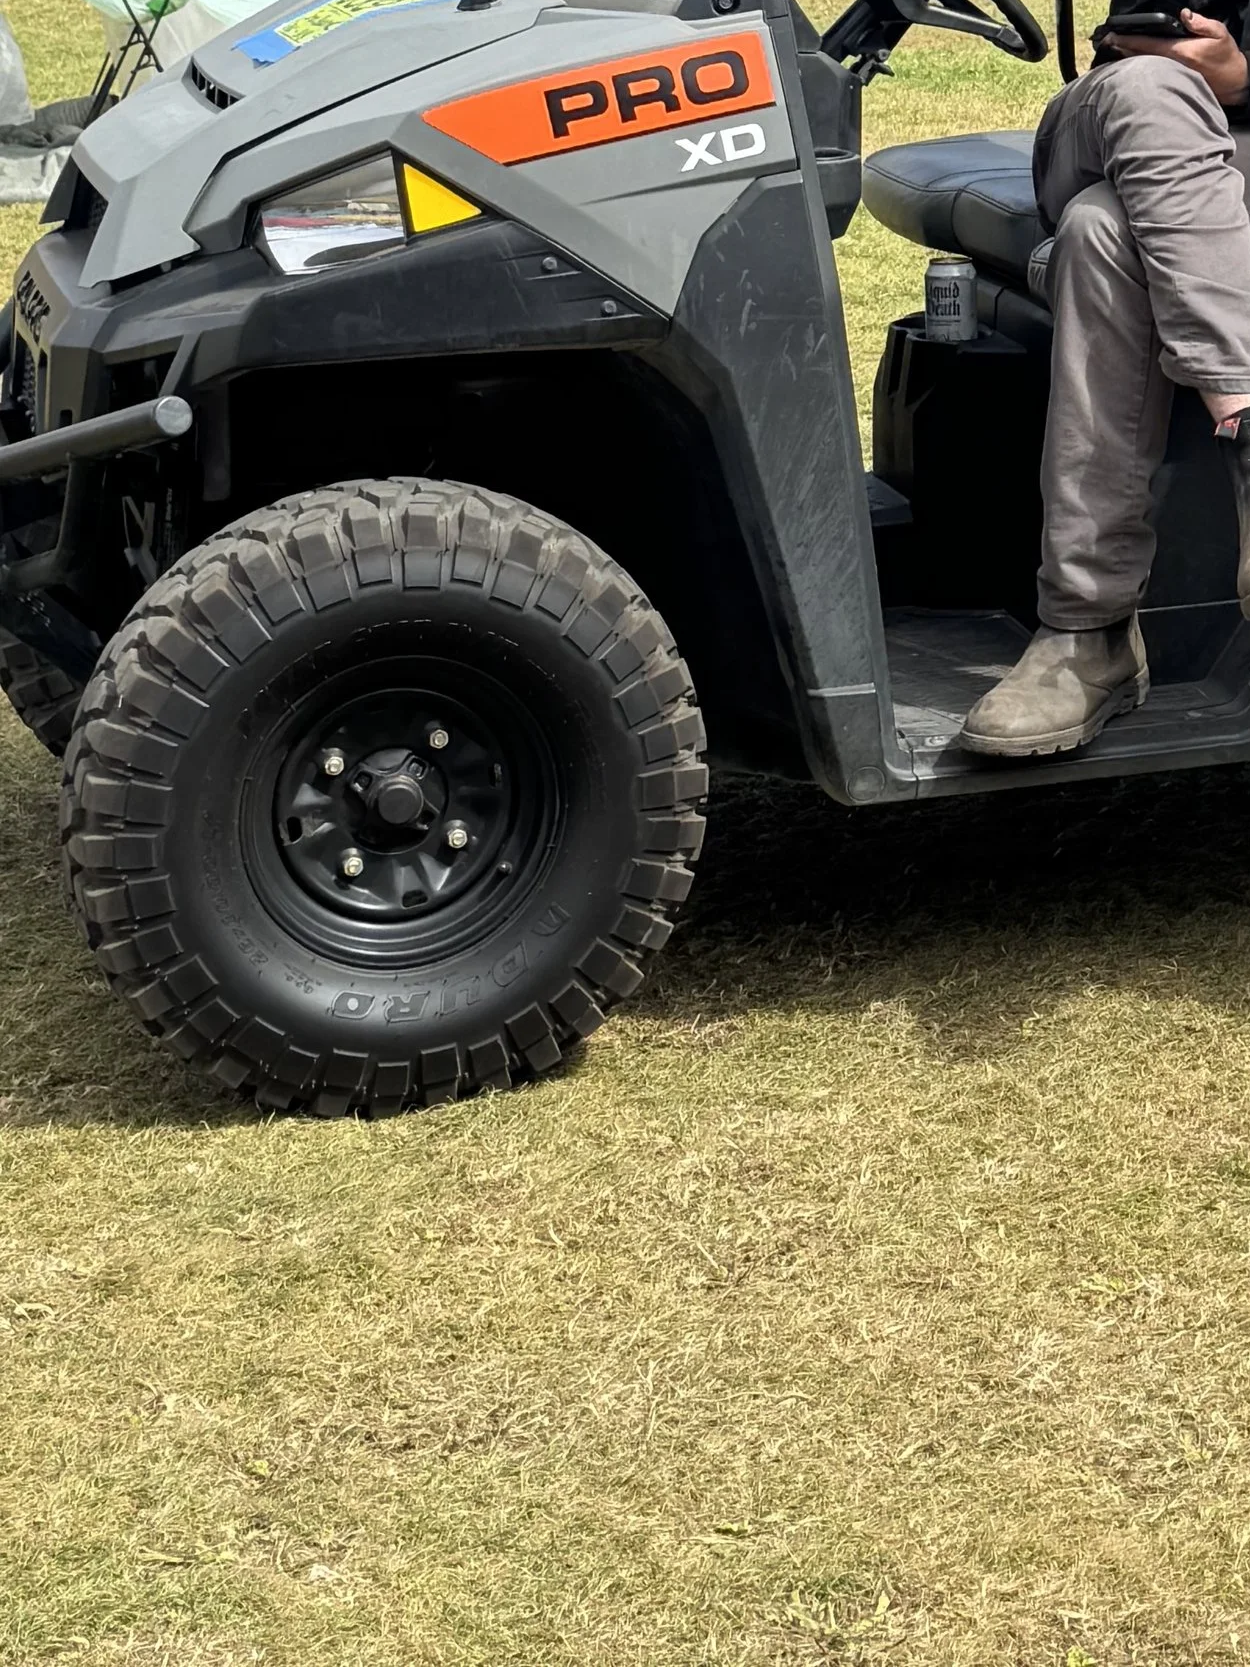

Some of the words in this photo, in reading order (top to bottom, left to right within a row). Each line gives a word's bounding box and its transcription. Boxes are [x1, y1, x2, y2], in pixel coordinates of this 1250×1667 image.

[544, 50, 750, 139] PRO
[675, 123, 767, 173] XD
[926, 281, 960, 303] iquid
